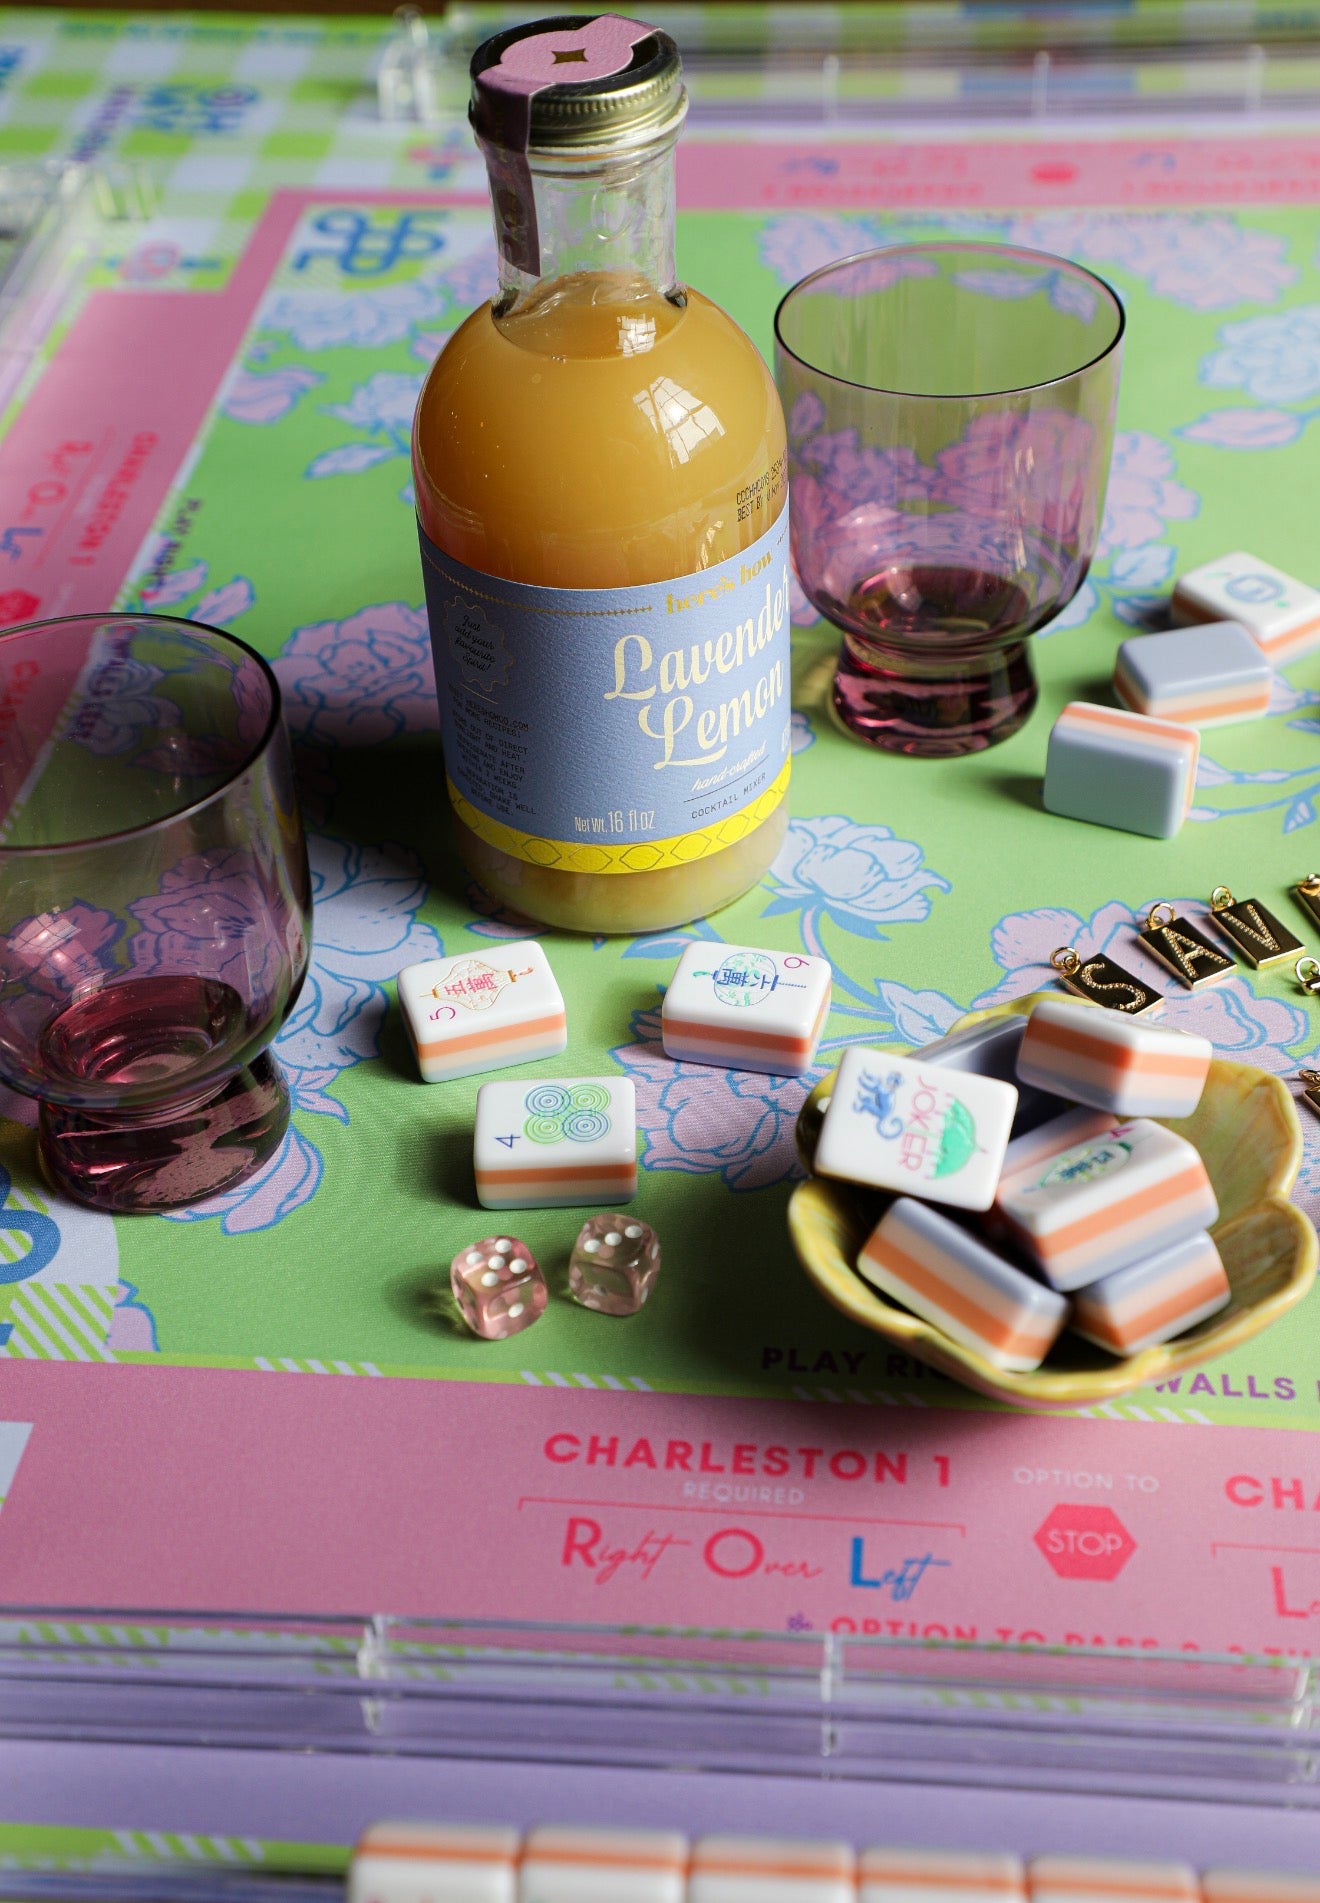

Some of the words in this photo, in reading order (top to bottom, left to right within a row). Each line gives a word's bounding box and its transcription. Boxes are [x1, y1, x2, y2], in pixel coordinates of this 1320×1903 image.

[638, 660, 784, 770] Lemon
[691, 794, 738, 819] COCKTAIL
[743, 772, 767, 796] MIXER
[574, 816, 591, 832] Net
[608, 811, 624, 833] 16
[1162, 927, 1230, 979] A
[1222, 904, 1281, 951] V
[429, 1006, 456, 1021] 5
[900, 1076, 937, 1170] JOKER
[495, 1133, 521, 1149] 4
[761, 1346, 866, 1374] PLAY
[543, 1432, 909, 1485] CHARLESTON
[934, 1454, 950, 1488] 1
[682, 1480, 805, 1506] REQUIRED
[1013, 1467, 1113, 1490] OPTION
[1125, 1475, 1160, 1495] TO
[1046, 1527, 1123, 1557] STOP
[562, 1517, 692, 1586] Right
[703, 1527, 823, 1579] Over
[850, 1536, 952, 1602] Left
